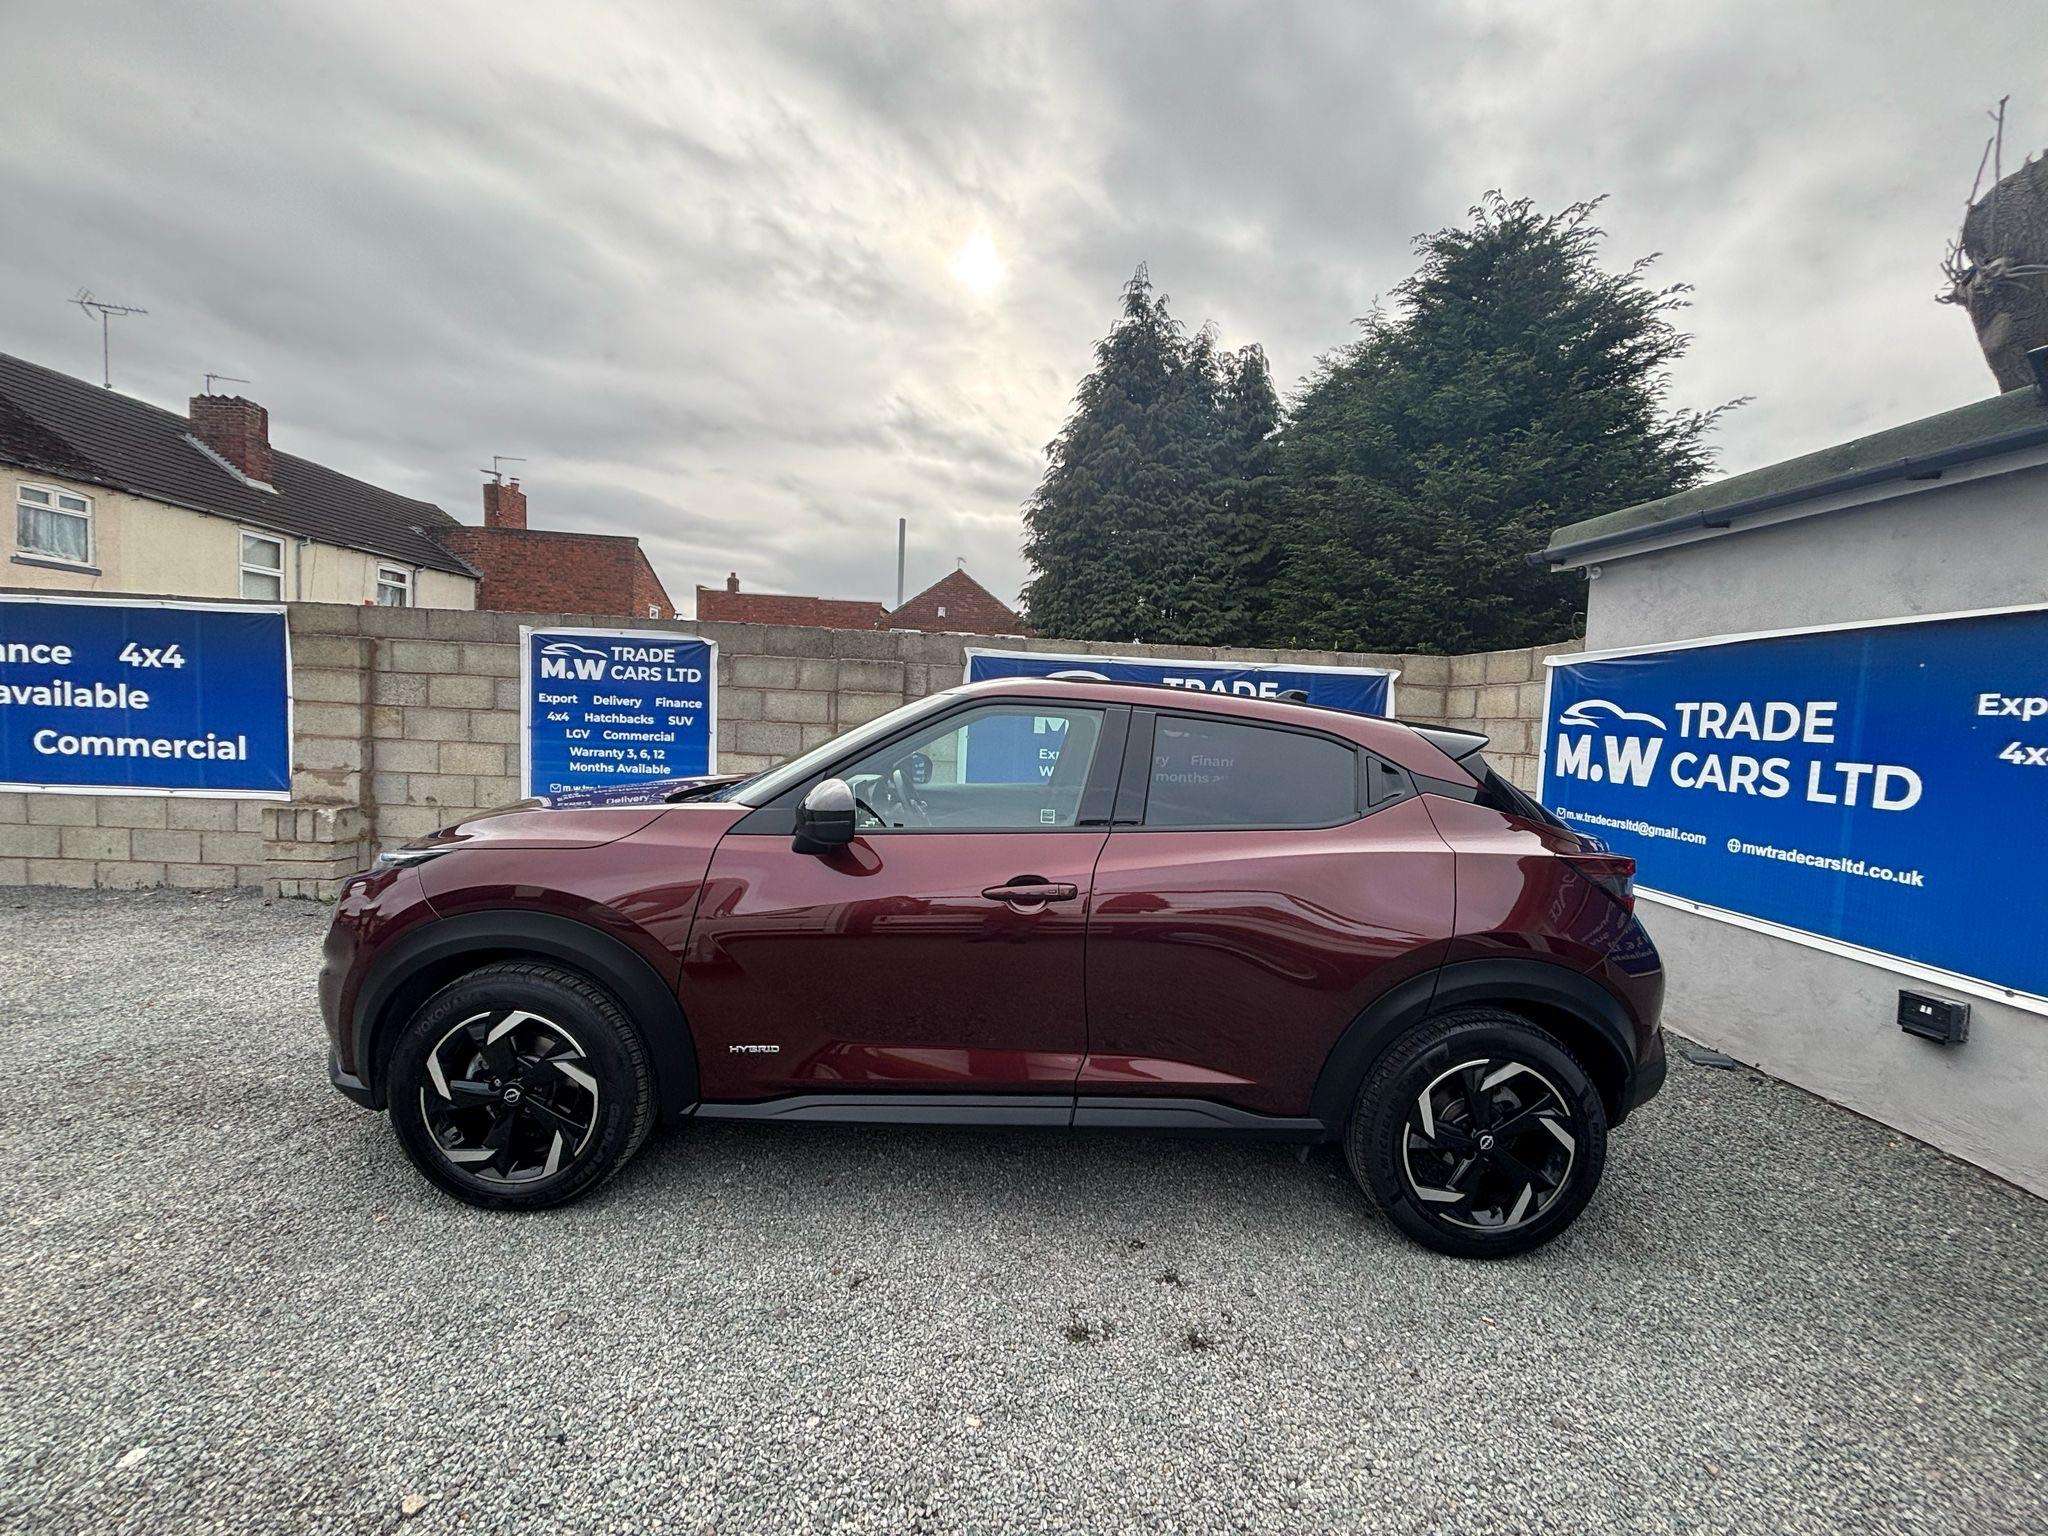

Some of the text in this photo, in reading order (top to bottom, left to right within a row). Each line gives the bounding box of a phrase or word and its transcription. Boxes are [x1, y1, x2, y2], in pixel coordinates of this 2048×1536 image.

[118, 642, 186, 669] 4x4
[611, 646, 676, 664] TRADE
[540, 657, 606, 681] M.W
[610, 666, 702, 683] CARS LTD
[0, 680, 150, 710] available
[538, 693, 703, 709] Export Delivery Finance
[1977, 693, 2048, 721] Exp
[547, 711, 694, 726] 4x4 Hatchbacks SUV
[1674, 701, 1838, 744] TRADE
[33, 729, 247, 762] Commercial
[566, 729, 675, 742] LGV Commercial
[569, 746, 665, 760] Warranty 3, 6, 12
[1554, 733, 1663, 788] M.W
[1998, 741, 2048, 766] 4x
[569, 762, 671, 775] Months Available
[1671, 751, 1923, 811] CARS LTD
[1566, 810, 1707, 846] m.w.tradecarsltd@gmail.com
[1742, 841, 1924, 888] mwtradecarsltd.co.uk
[729, 1045, 780, 1053] HYBRID
